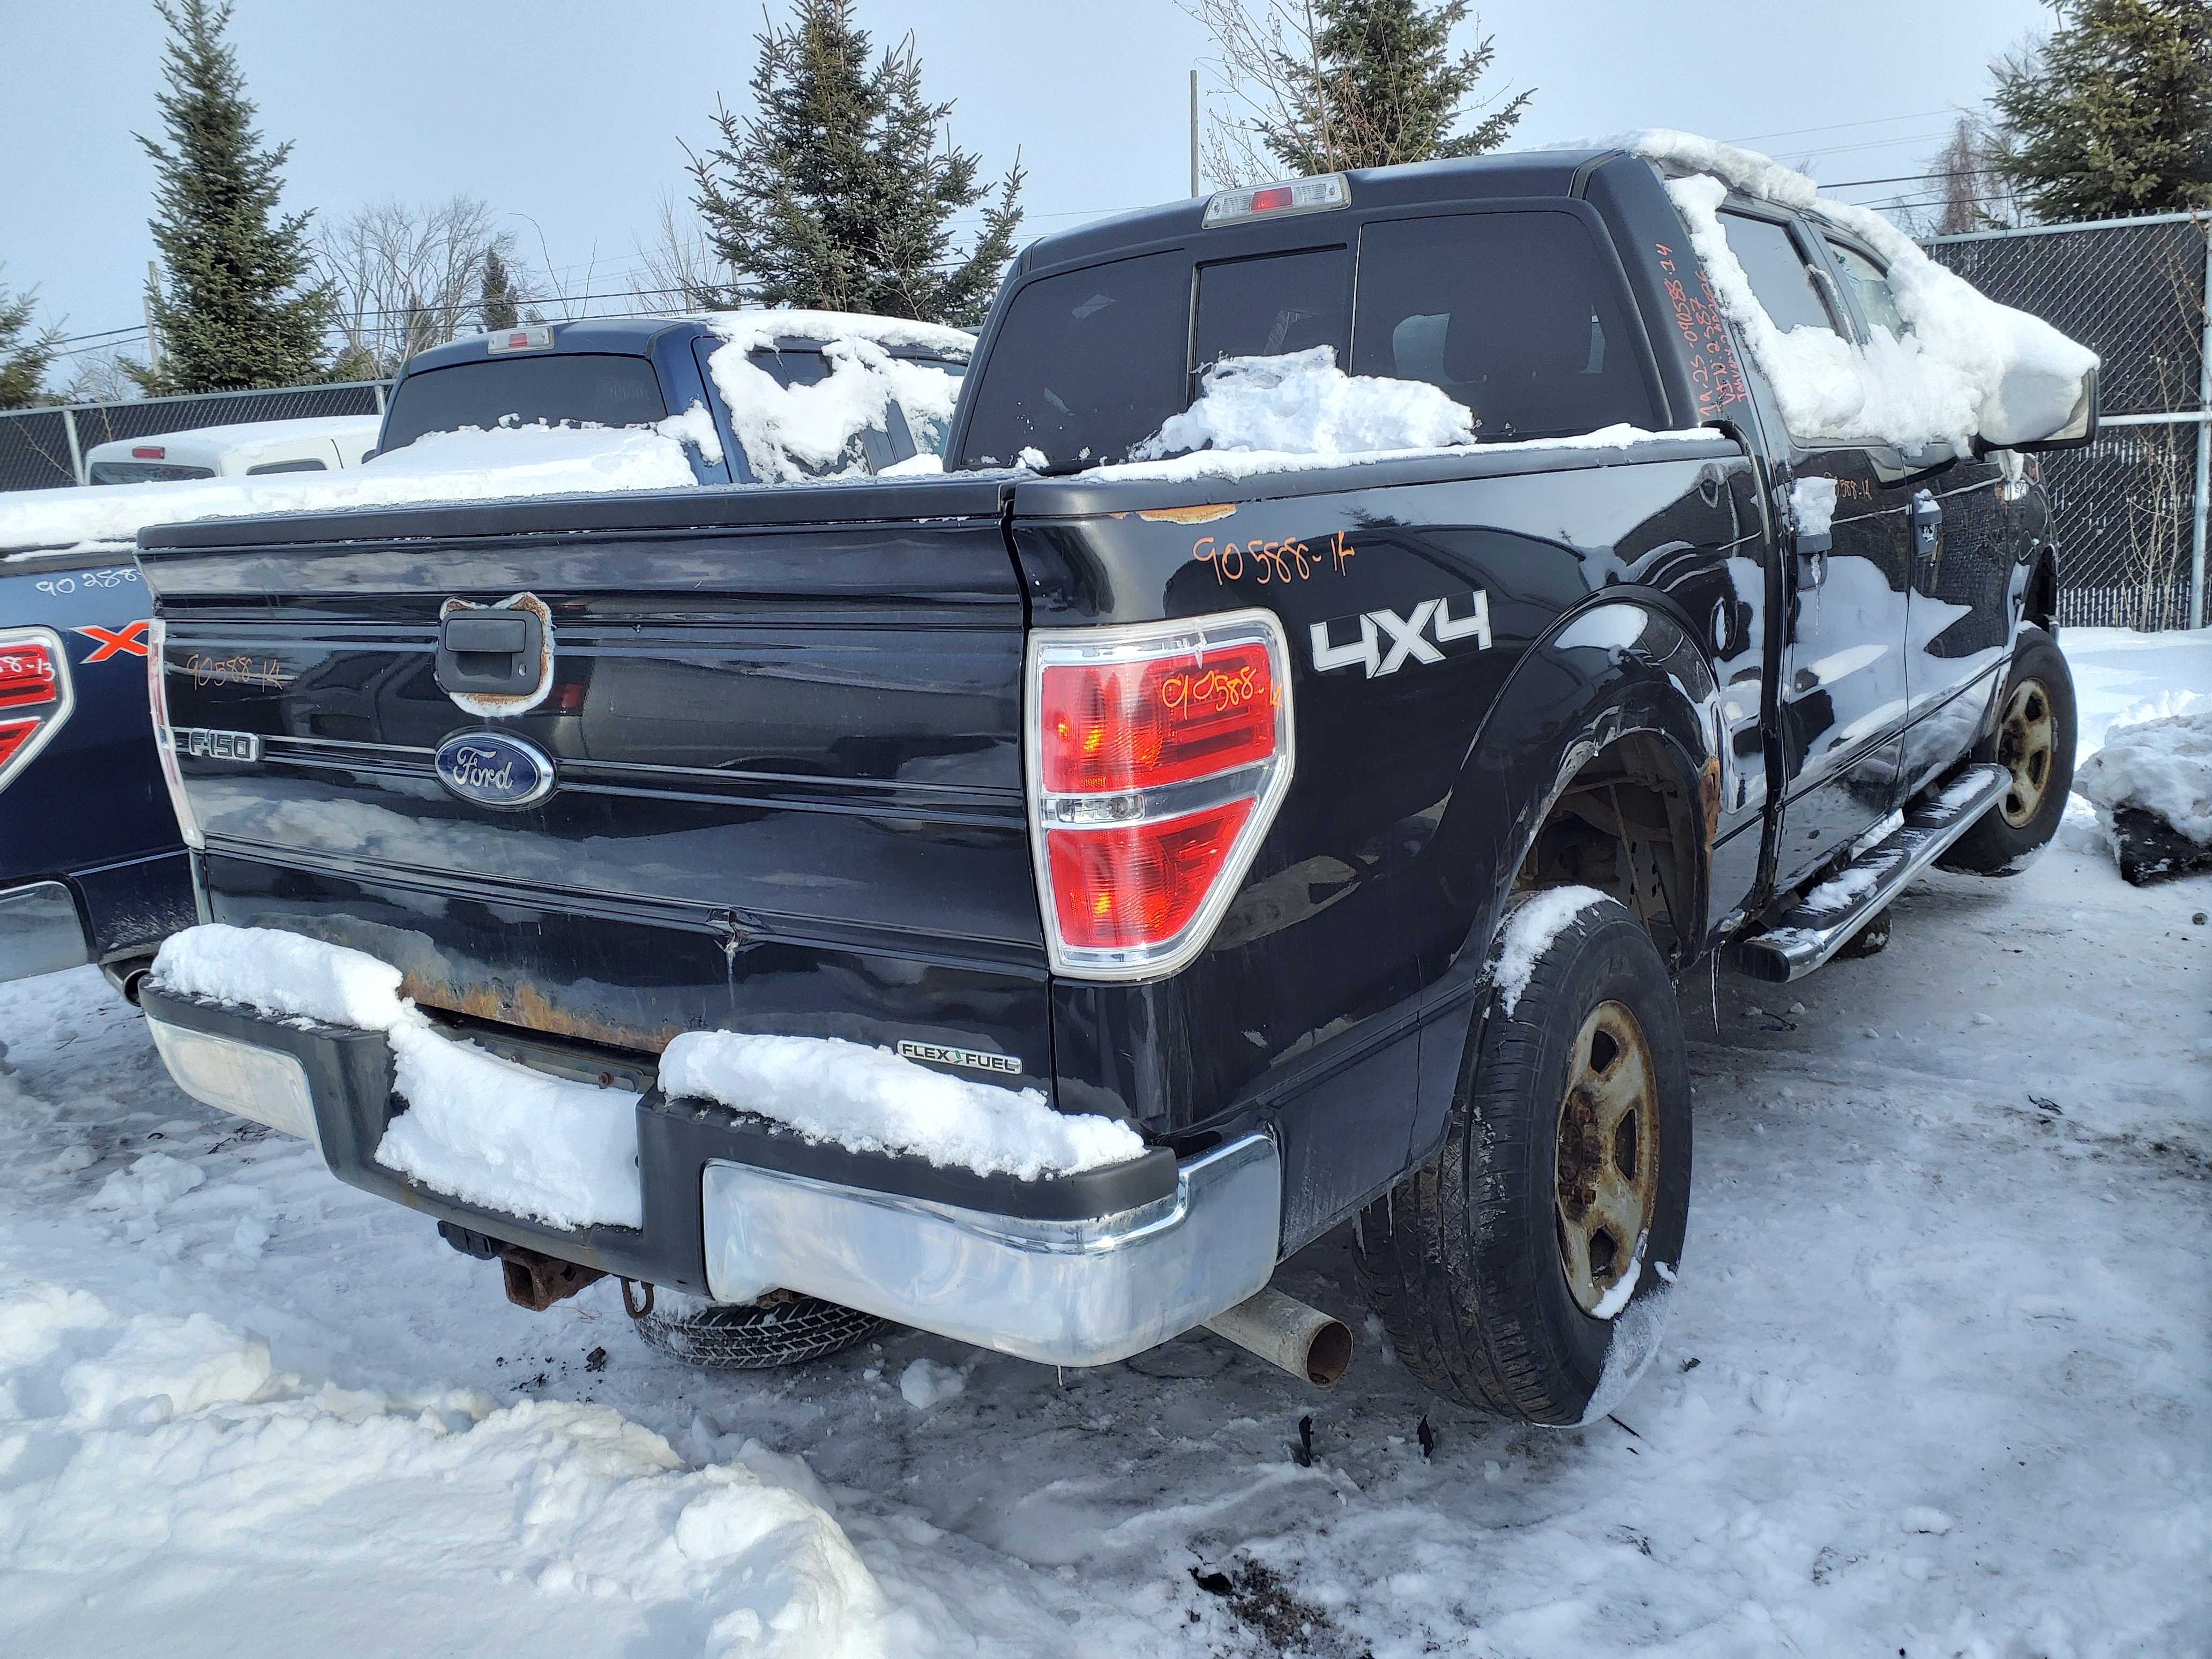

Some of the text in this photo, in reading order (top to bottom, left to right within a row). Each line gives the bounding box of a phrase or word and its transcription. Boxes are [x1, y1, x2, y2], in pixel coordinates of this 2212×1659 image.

[1309, 589, 1492, 679] 4X4
[0, 656, 56, 682] 8-13
[189, 727, 260, 763] F-150
[453, 746, 513, 790] Ford
[902, 1044, 1015, 1072] FLEX FUEL
